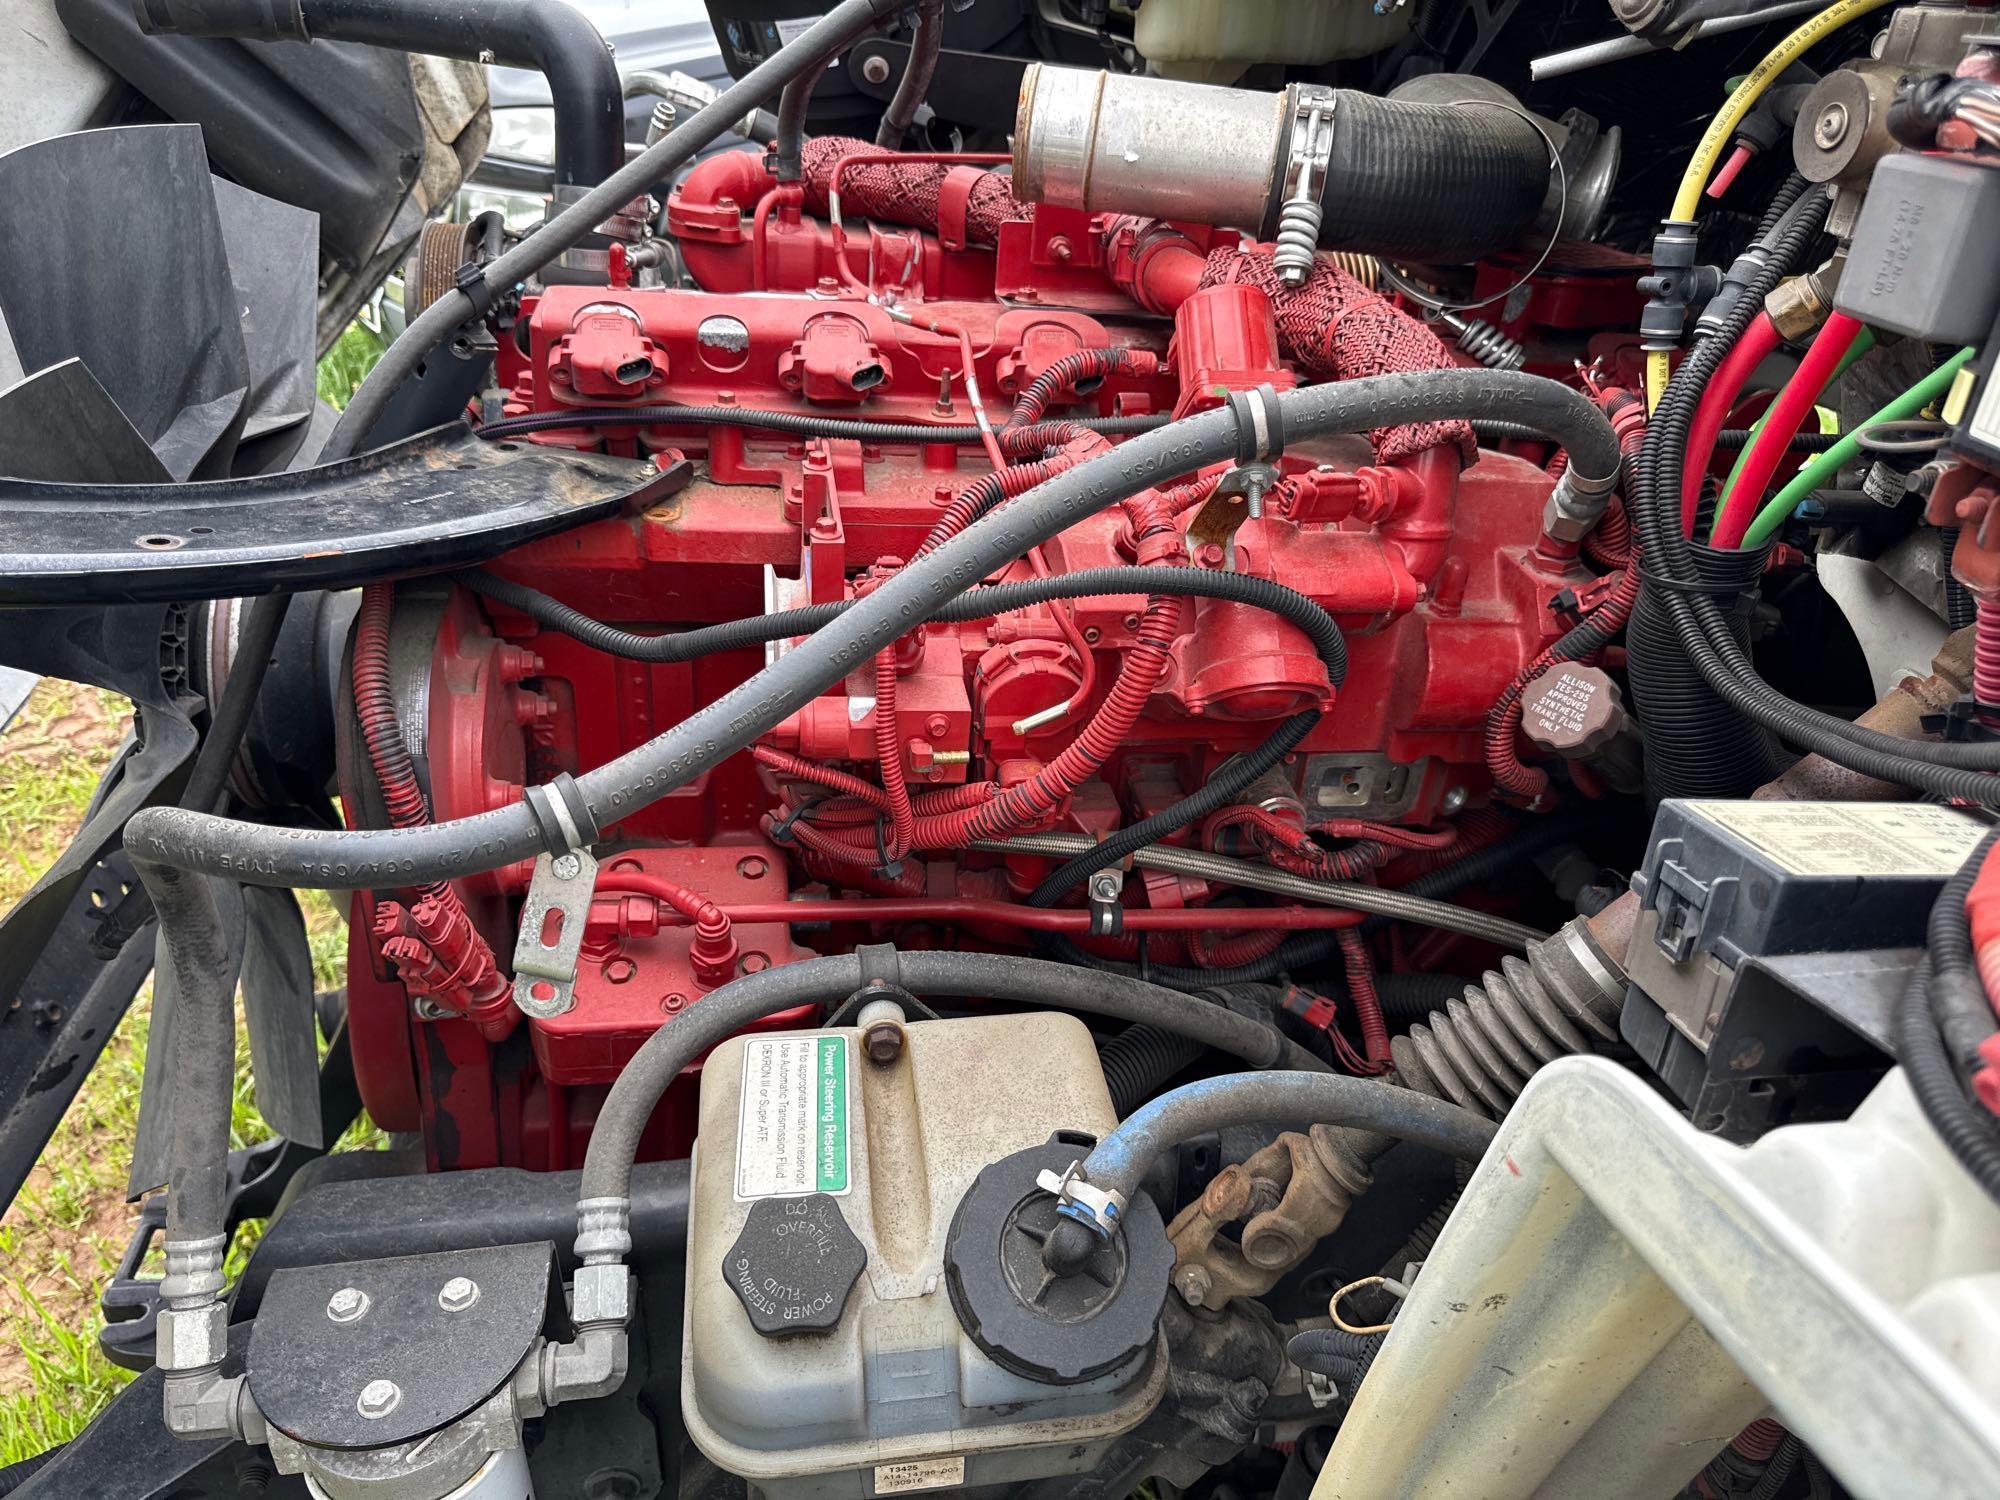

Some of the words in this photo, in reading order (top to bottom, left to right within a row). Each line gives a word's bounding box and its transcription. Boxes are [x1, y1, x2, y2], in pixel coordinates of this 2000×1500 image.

[1701, 144, 1713, 155] THE
[1118, 437, 1205, 485] CGA/CSA
[1060, 478, 1109, 513] TYPE
[929, 553, 983, 596] ISSUE
[827, 615, 894, 668] E-8631
[1555, 681, 1591, 702] TES-295
[1560, 673, 1596, 693] ALLISON
[1539, 696, 1585, 722] SYNTHETIC
[1546, 689, 1588, 712] APPROVED
[724, 690, 781, 738] Parker
[1530, 703, 1557, 720] TRANS
[1558, 716, 1583, 732] FLUID
[1538, 718, 1561, 733] ONLY
[606, 736, 719, 808] SS23CG-10
[219, 854, 277, 874] TYPE
[300, 855, 416, 876] CGA/CSA
[781, 1043, 791, 1058] Use
[799, 1042, 810, 1053] Fill
[799, 1054, 808, 1063] to
[824, 1044, 837, 1076] Power
[761, 1044, 773, 1078] DEXRON
[778, 1060, 790, 1099] Automatic
[794, 1064, 808, 1109] appropriate
[760, 1089, 769, 1098] or
[821, 1078, 837, 1121] Steering
[757, 1099, 770, 1124] Super
[798, 1110, 808, 1131] mark
[777, 1101, 789, 1155] Transmission
[797, 1133, 806, 1145] on
[824, 1124, 837, 1180] Reservoir
[775, 1157, 787, 1179] Fluid
[785, 1201, 808, 1215] DO
[776, 1220, 834, 1257] OVERFILL
[736, 1258, 777, 1315] STEERING
[763, 1277, 801, 1301] FLUID
[783, 1290, 833, 1319] POWER
[889, 1464, 918, 1473] T3425
[889, 1477, 923, 1487] 130916
